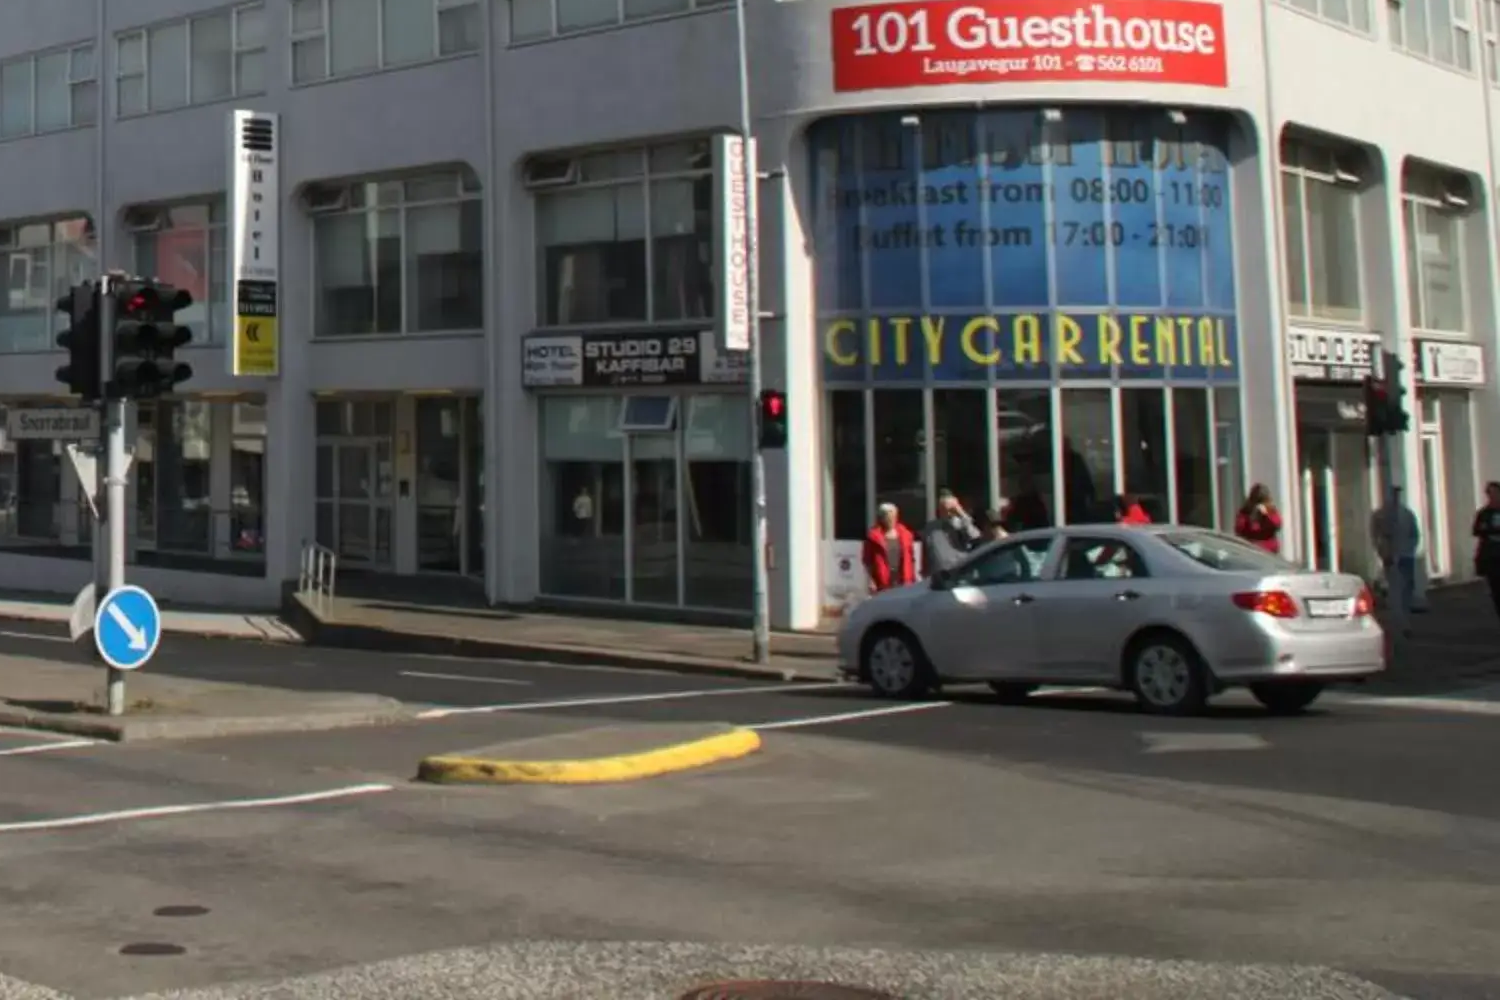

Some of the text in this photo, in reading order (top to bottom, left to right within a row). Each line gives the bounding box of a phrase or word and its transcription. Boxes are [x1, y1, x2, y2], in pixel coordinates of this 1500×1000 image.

[852, 4, 1215, 55] 101 Guesthouse
[923, 56, 1028, 75] Laugavegur
[1032, 55, 1062, 70] 101
[1097, 55, 1126, 70] 562
[584, 337, 696, 358] STUDIO 29
[825, 314, 1232, 367] CITY CAR RENTAL
[596, 357, 686, 374] KAFFIBAR
